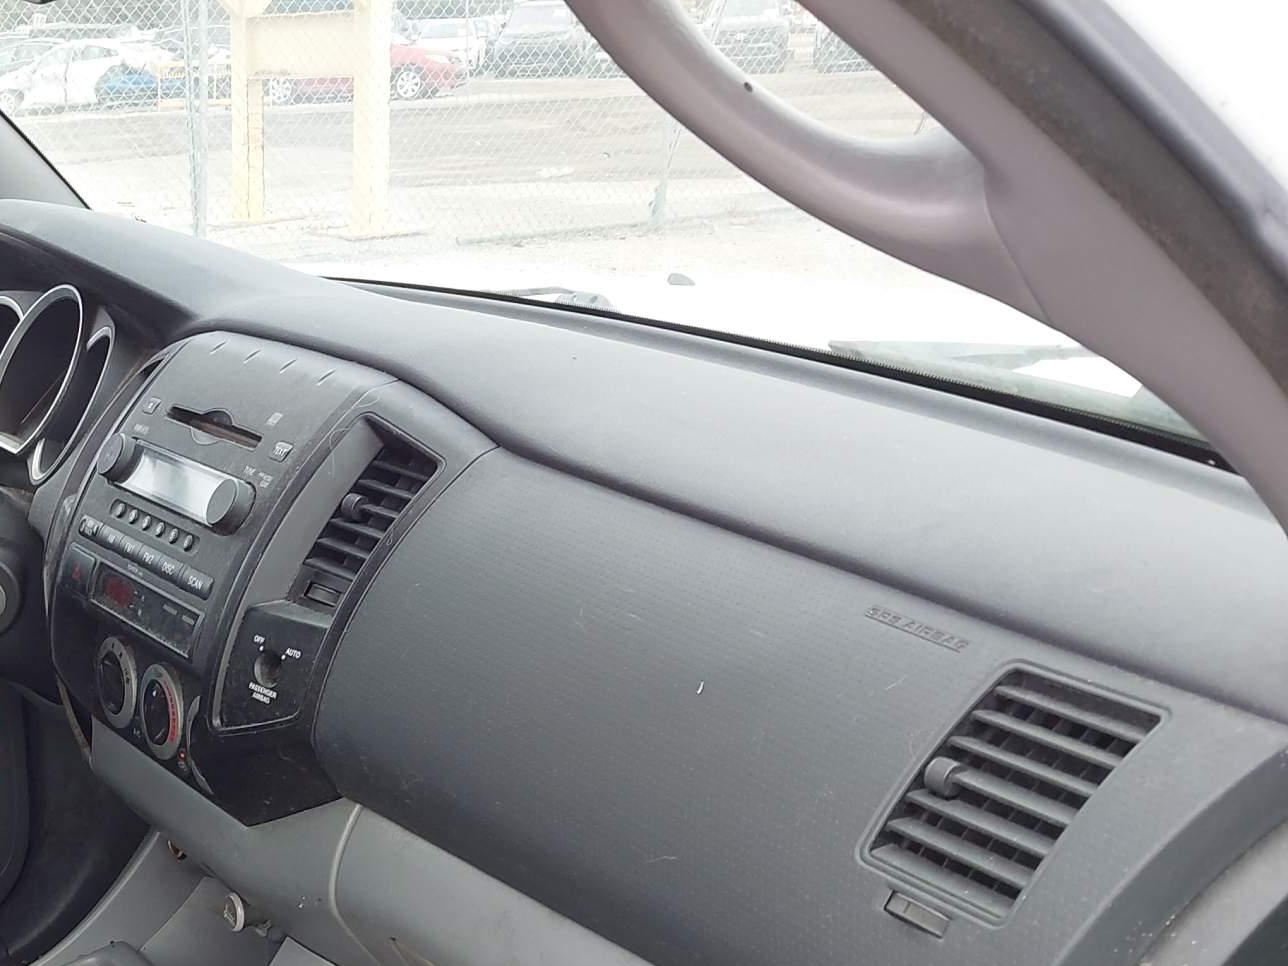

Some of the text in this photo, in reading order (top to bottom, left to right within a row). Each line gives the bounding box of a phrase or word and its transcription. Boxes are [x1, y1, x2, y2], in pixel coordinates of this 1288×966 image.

[187, 575, 204, 590] SCAN
[866, 606, 970, 650] SRS AIRBAG
[253, 634, 266, 644] OFF
[285, 647, 302, 659] AUTO
